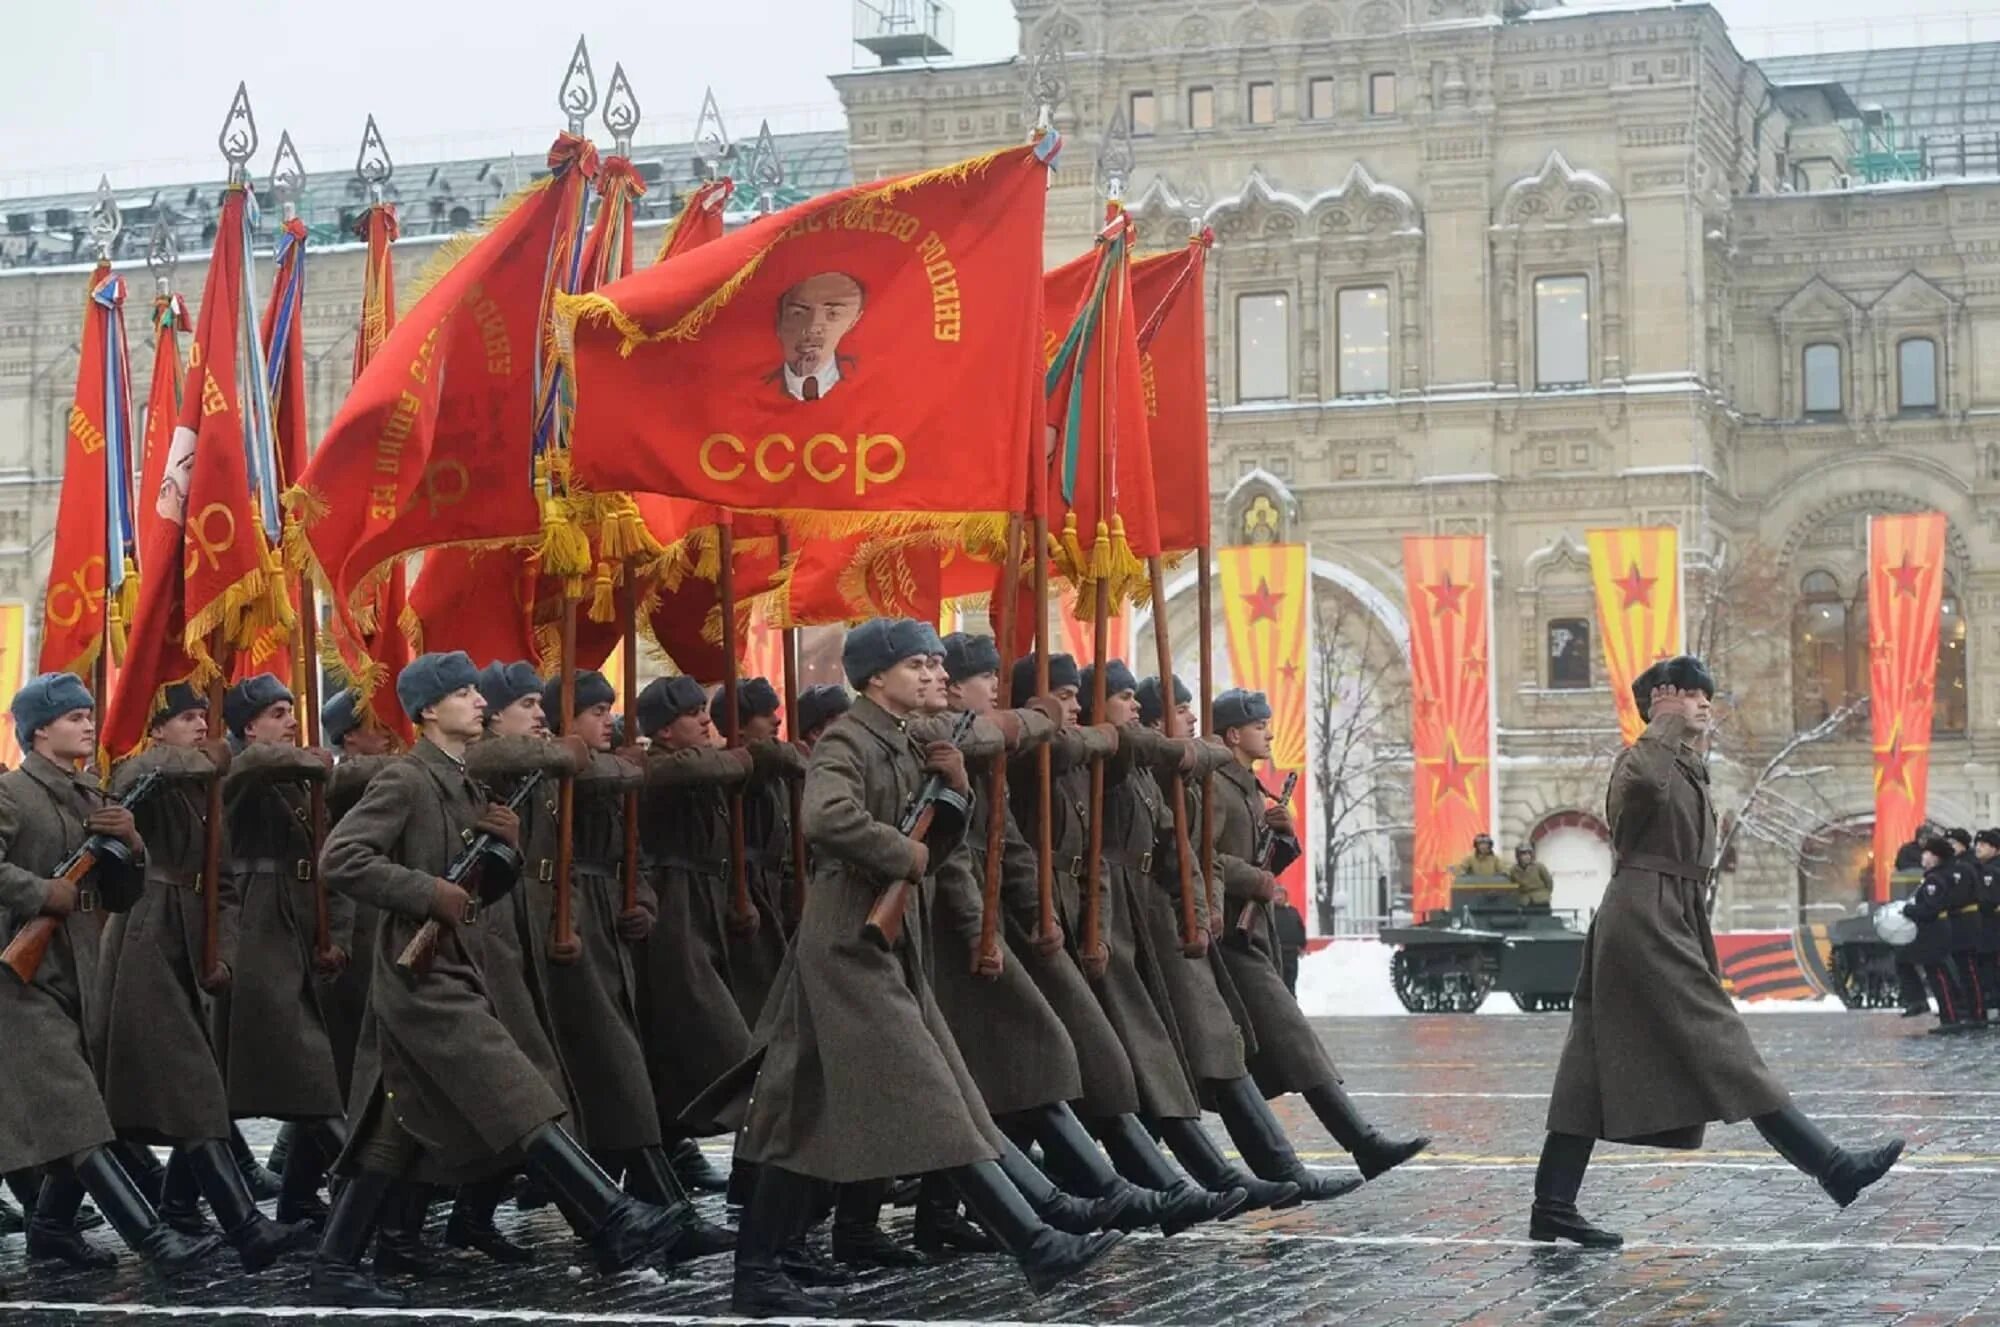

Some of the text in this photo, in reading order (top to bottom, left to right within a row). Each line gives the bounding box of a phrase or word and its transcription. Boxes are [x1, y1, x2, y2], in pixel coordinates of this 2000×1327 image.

[916, 230, 961, 342] РОДИНУ
[699, 433, 906, 495] СССР
[371, 483, 397, 519] ЗА
